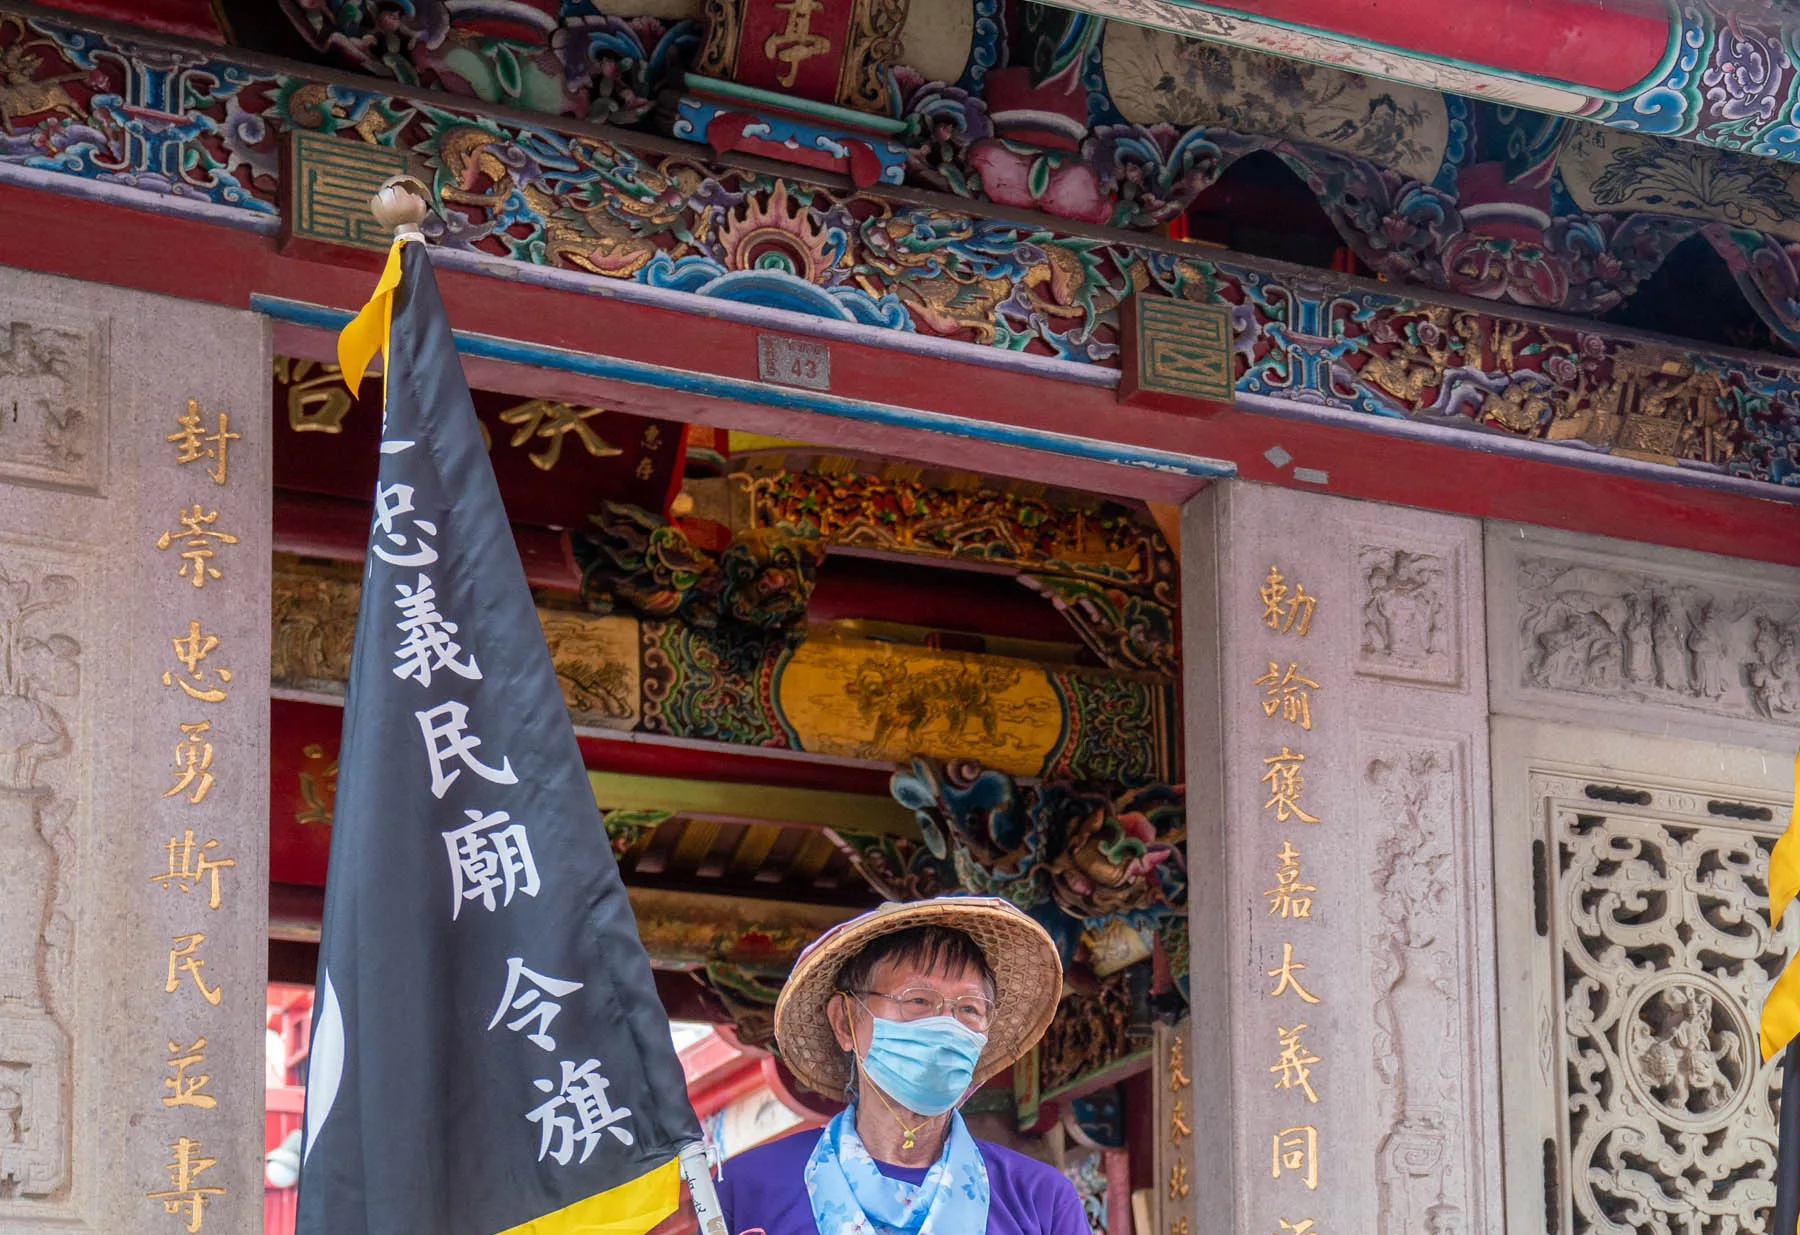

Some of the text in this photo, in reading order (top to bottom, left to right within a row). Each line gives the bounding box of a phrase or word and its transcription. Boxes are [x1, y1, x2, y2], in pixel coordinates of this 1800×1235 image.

[372, 412, 635, 1167] 忠義民廟令旗
